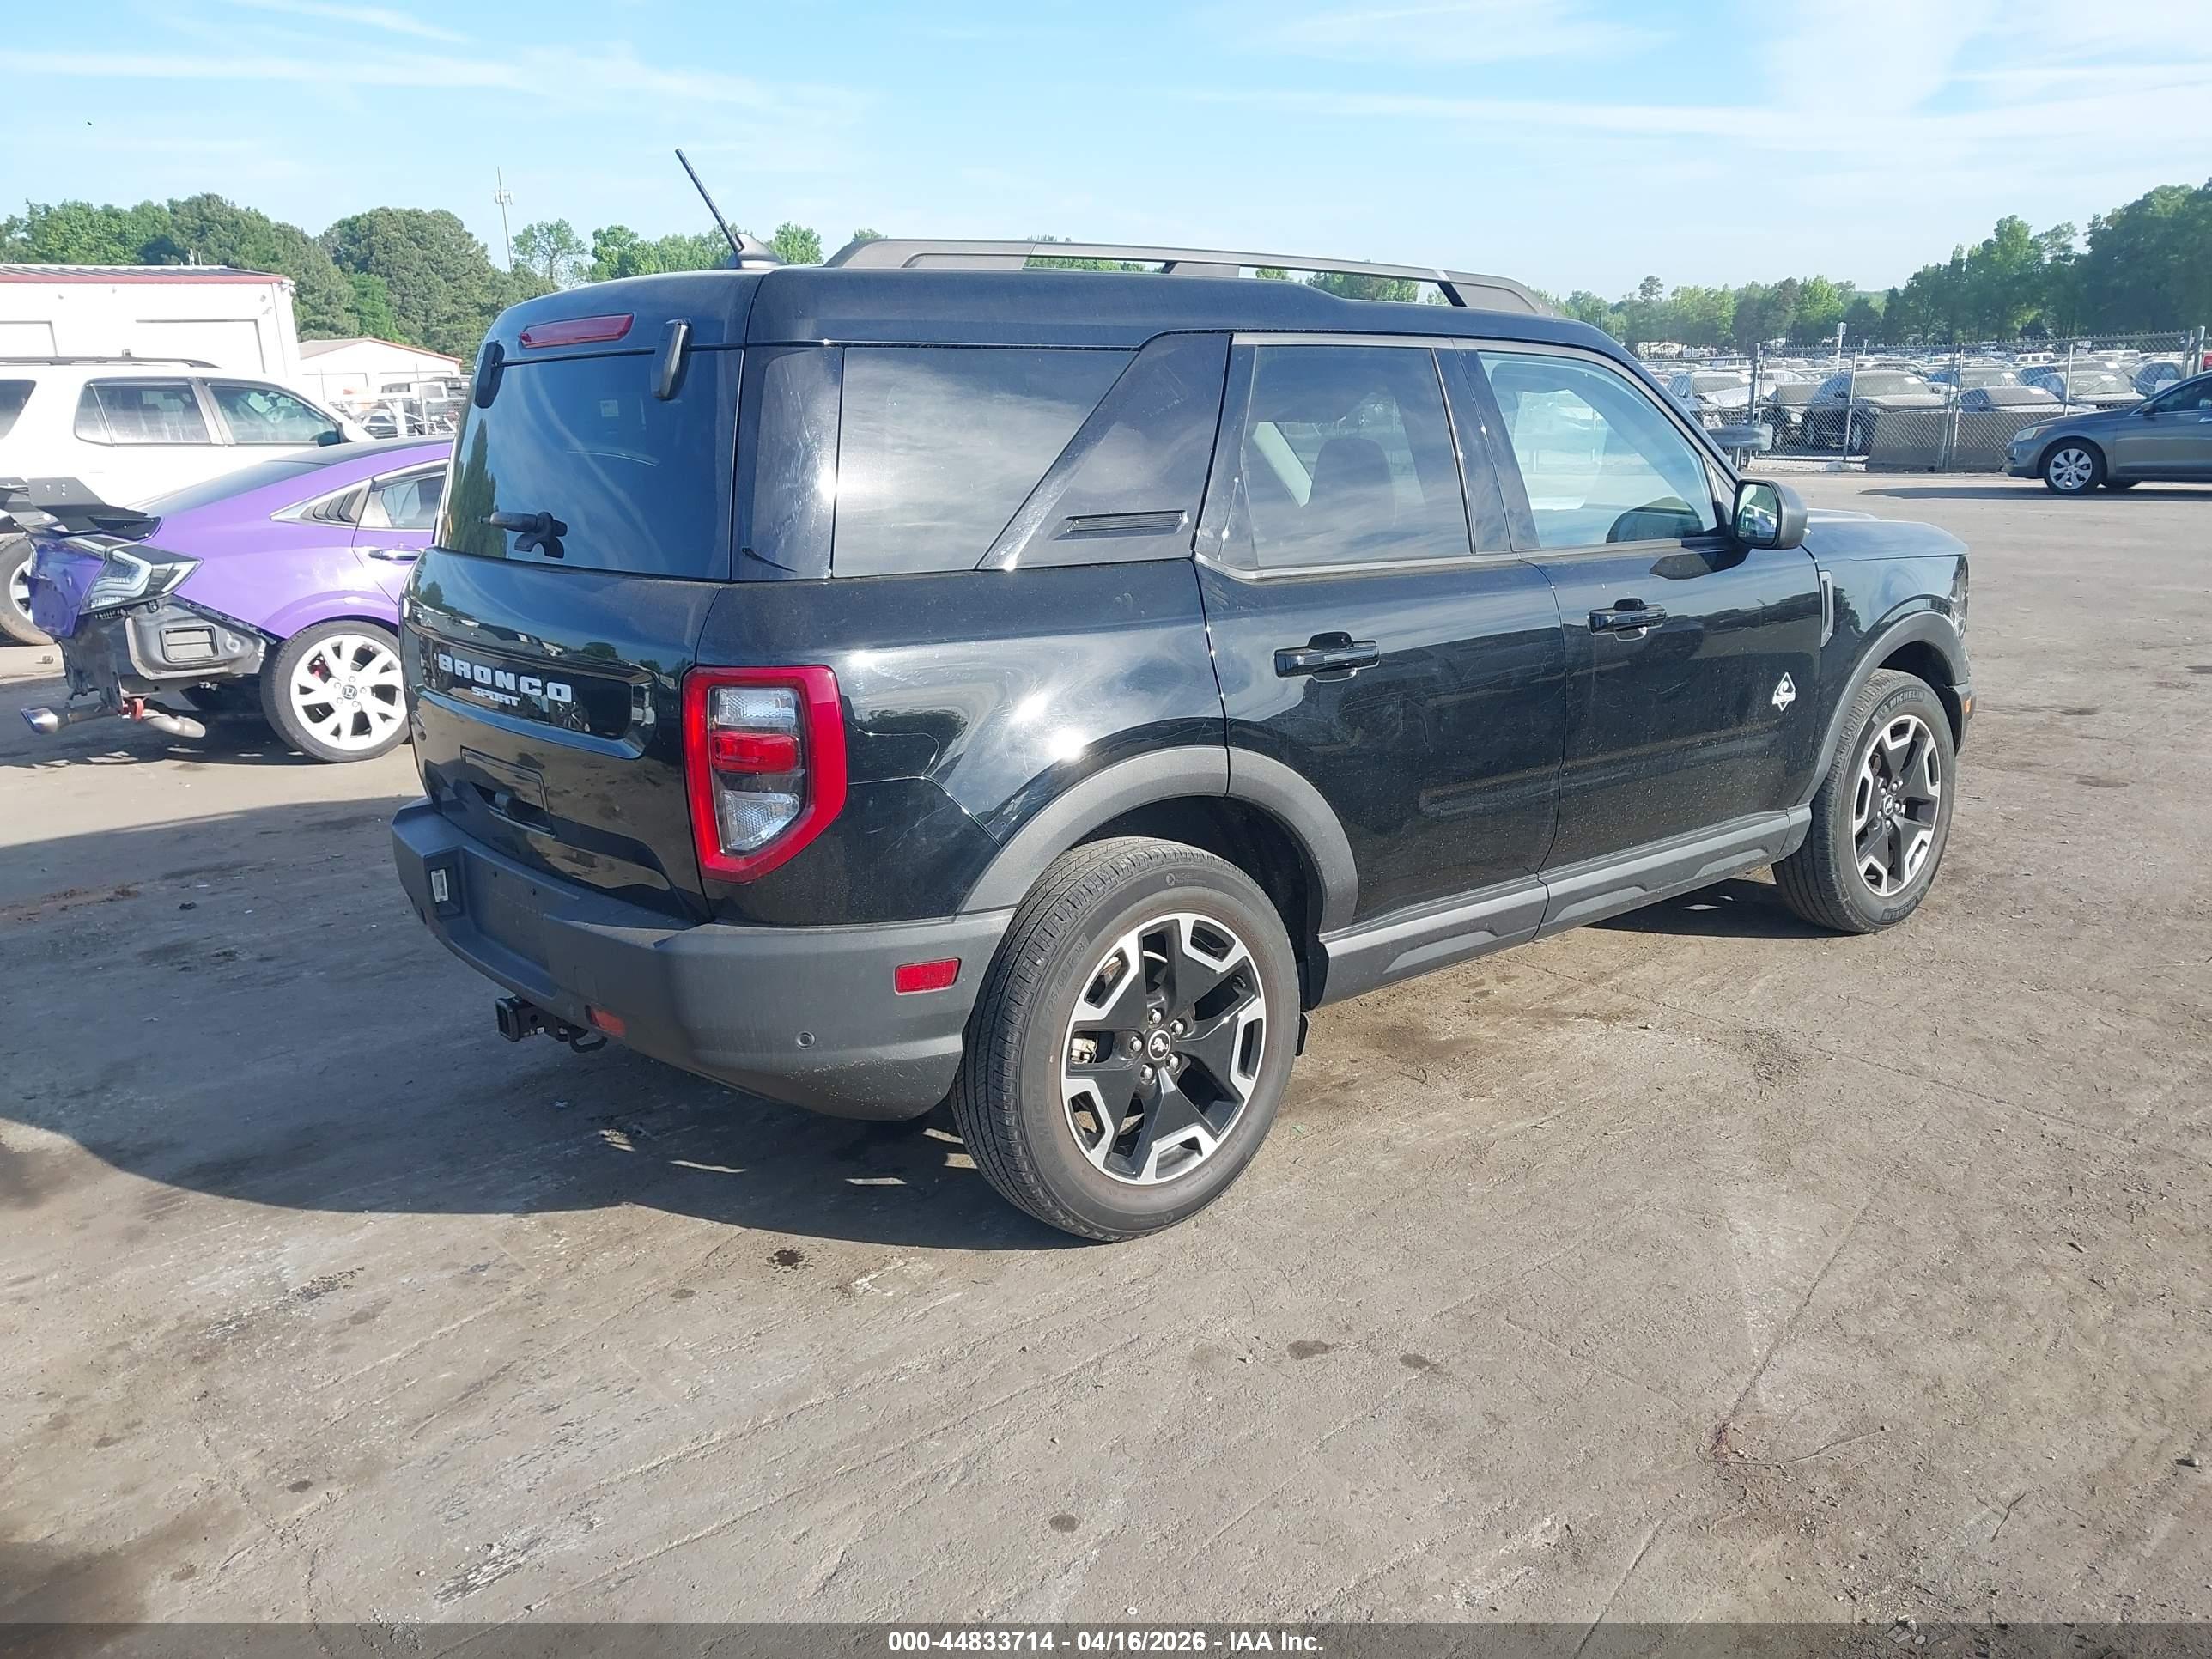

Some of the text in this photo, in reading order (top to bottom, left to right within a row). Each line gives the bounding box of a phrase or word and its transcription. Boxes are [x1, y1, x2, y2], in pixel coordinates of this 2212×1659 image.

[438, 653, 572, 702] BRONCO
[471, 686, 520, 707] SPORT
[1890, 690, 1923, 708] MICHELIN
